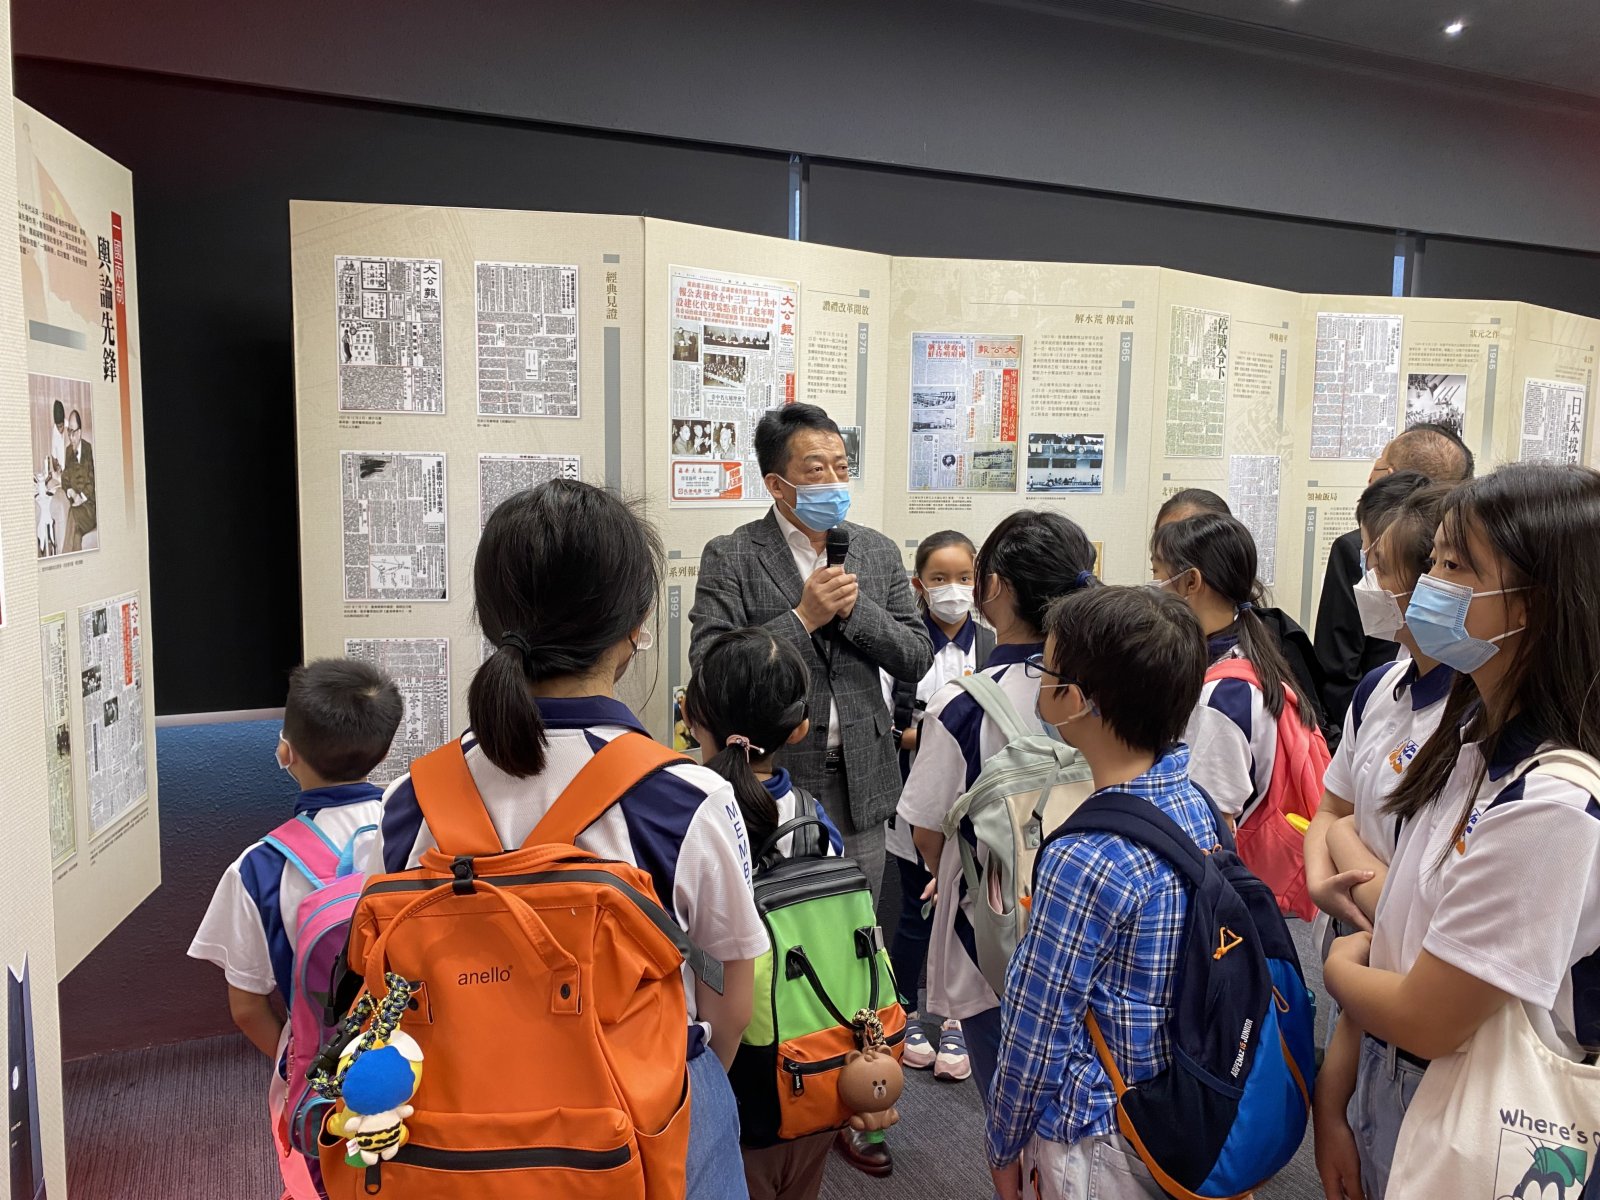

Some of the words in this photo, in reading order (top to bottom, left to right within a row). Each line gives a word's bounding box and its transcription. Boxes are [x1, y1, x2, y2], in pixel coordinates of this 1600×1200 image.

[423, 264, 437, 299] 大公報
[97, 234, 117, 383] 輿論先鋒
[606, 271, 618, 320] 經典見證
[780, 295, 795, 336] 大公報
[1074, 313, 1103, 325] 解水荒
[1106, 314, 1134, 325] 傳喜訊
[859, 327, 867, 354] 1978
[977, 345, 1016, 355] 大公報
[1121, 336, 1131, 362] 1965
[1488, 348, 1497, 370] 1945
[1306, 510, 1315, 532] 1945
[668, 565, 700, 577] 系列報
[669, 589, 679, 619] 1992
[457, 966, 511, 986] anello
[1230, 1049, 1245, 1078] ARPENAZ
[1240, 1018, 1254, 1043] JUNIOR
